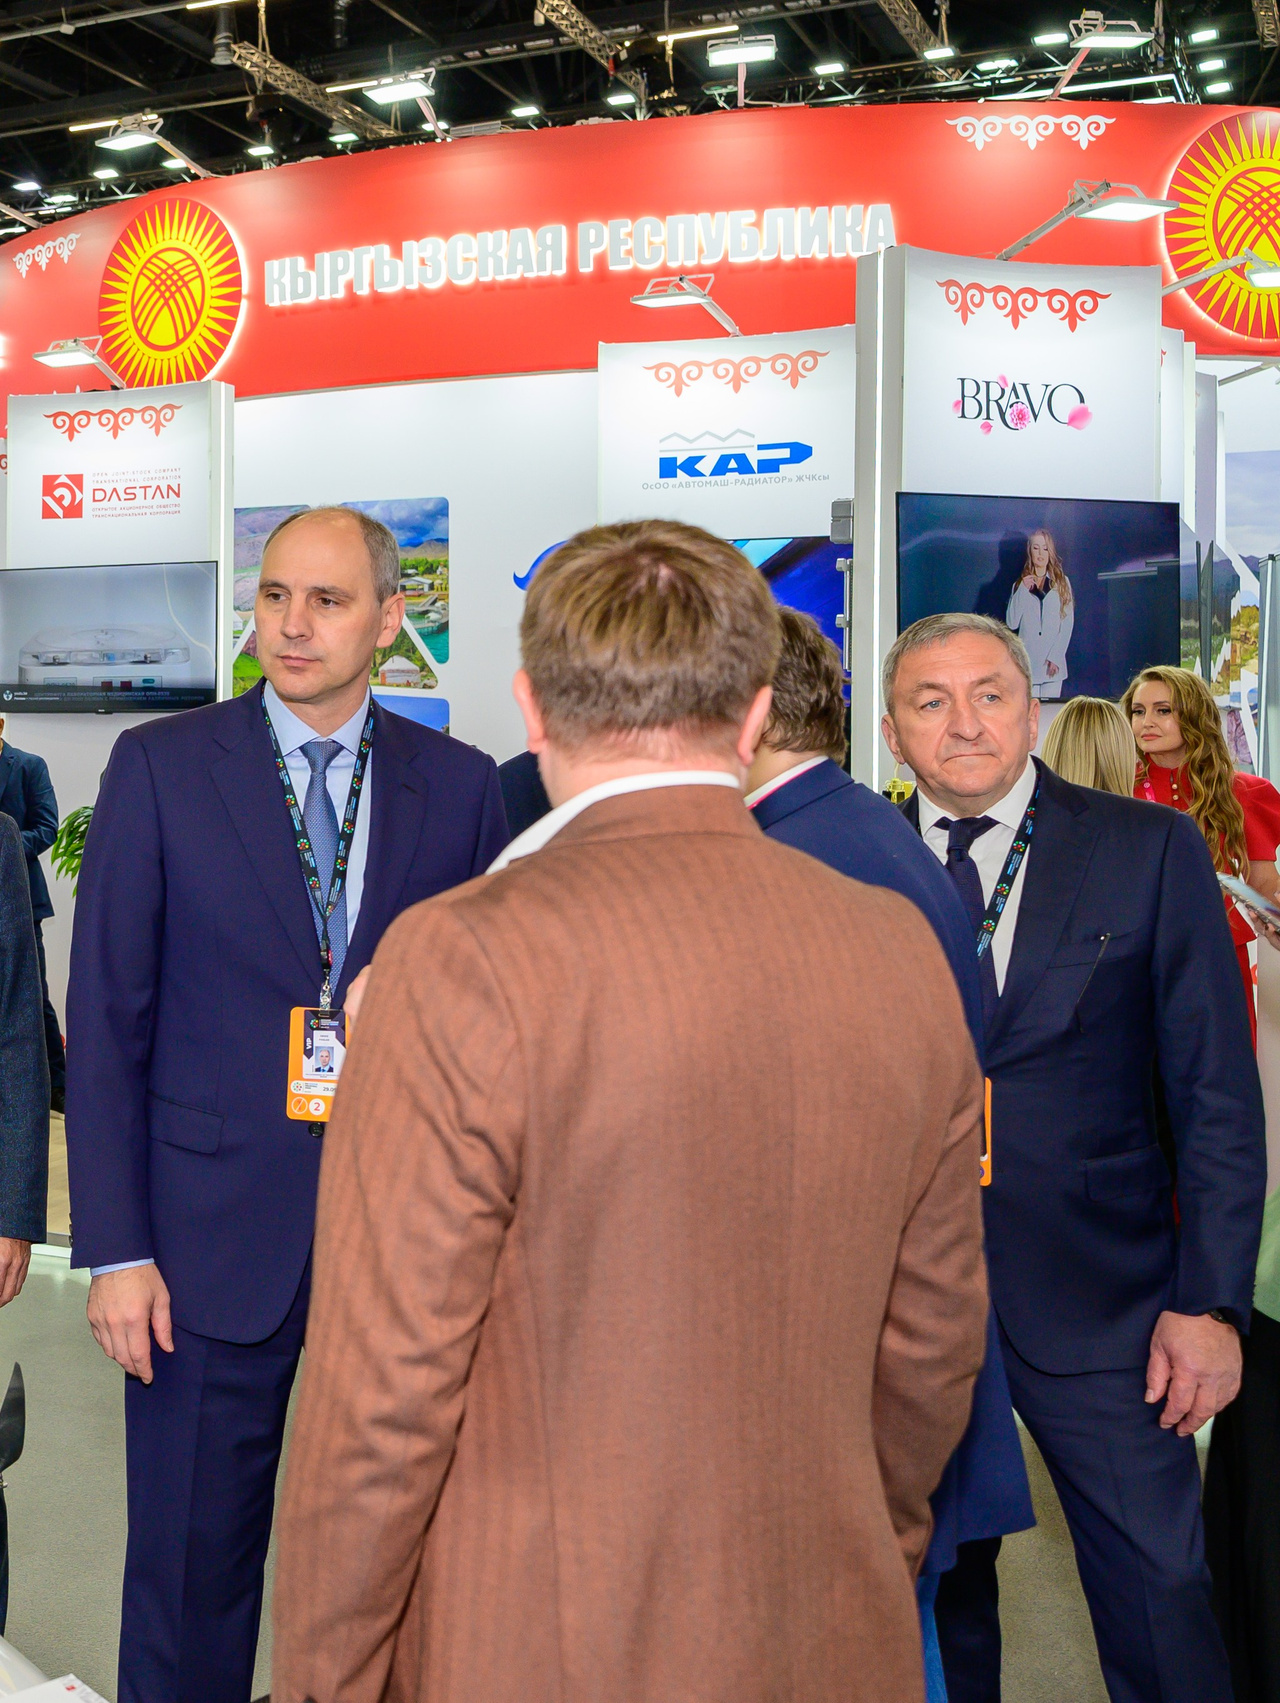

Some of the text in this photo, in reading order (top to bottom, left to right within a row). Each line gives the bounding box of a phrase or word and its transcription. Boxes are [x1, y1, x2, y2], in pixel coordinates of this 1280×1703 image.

[263, 203, 896, 305] КЫРГЫЗСКАЯ РЕСПУБЛИКА
[957, 377, 1086, 431] BRAVO
[641, 481, 670, 490] ОсОО
[671, 475, 793, 490] «АВТОМАШ-РАДИАТОР»
[92, 483, 181, 503] DASTAN
[314, 1102, 321, 1111] 2
